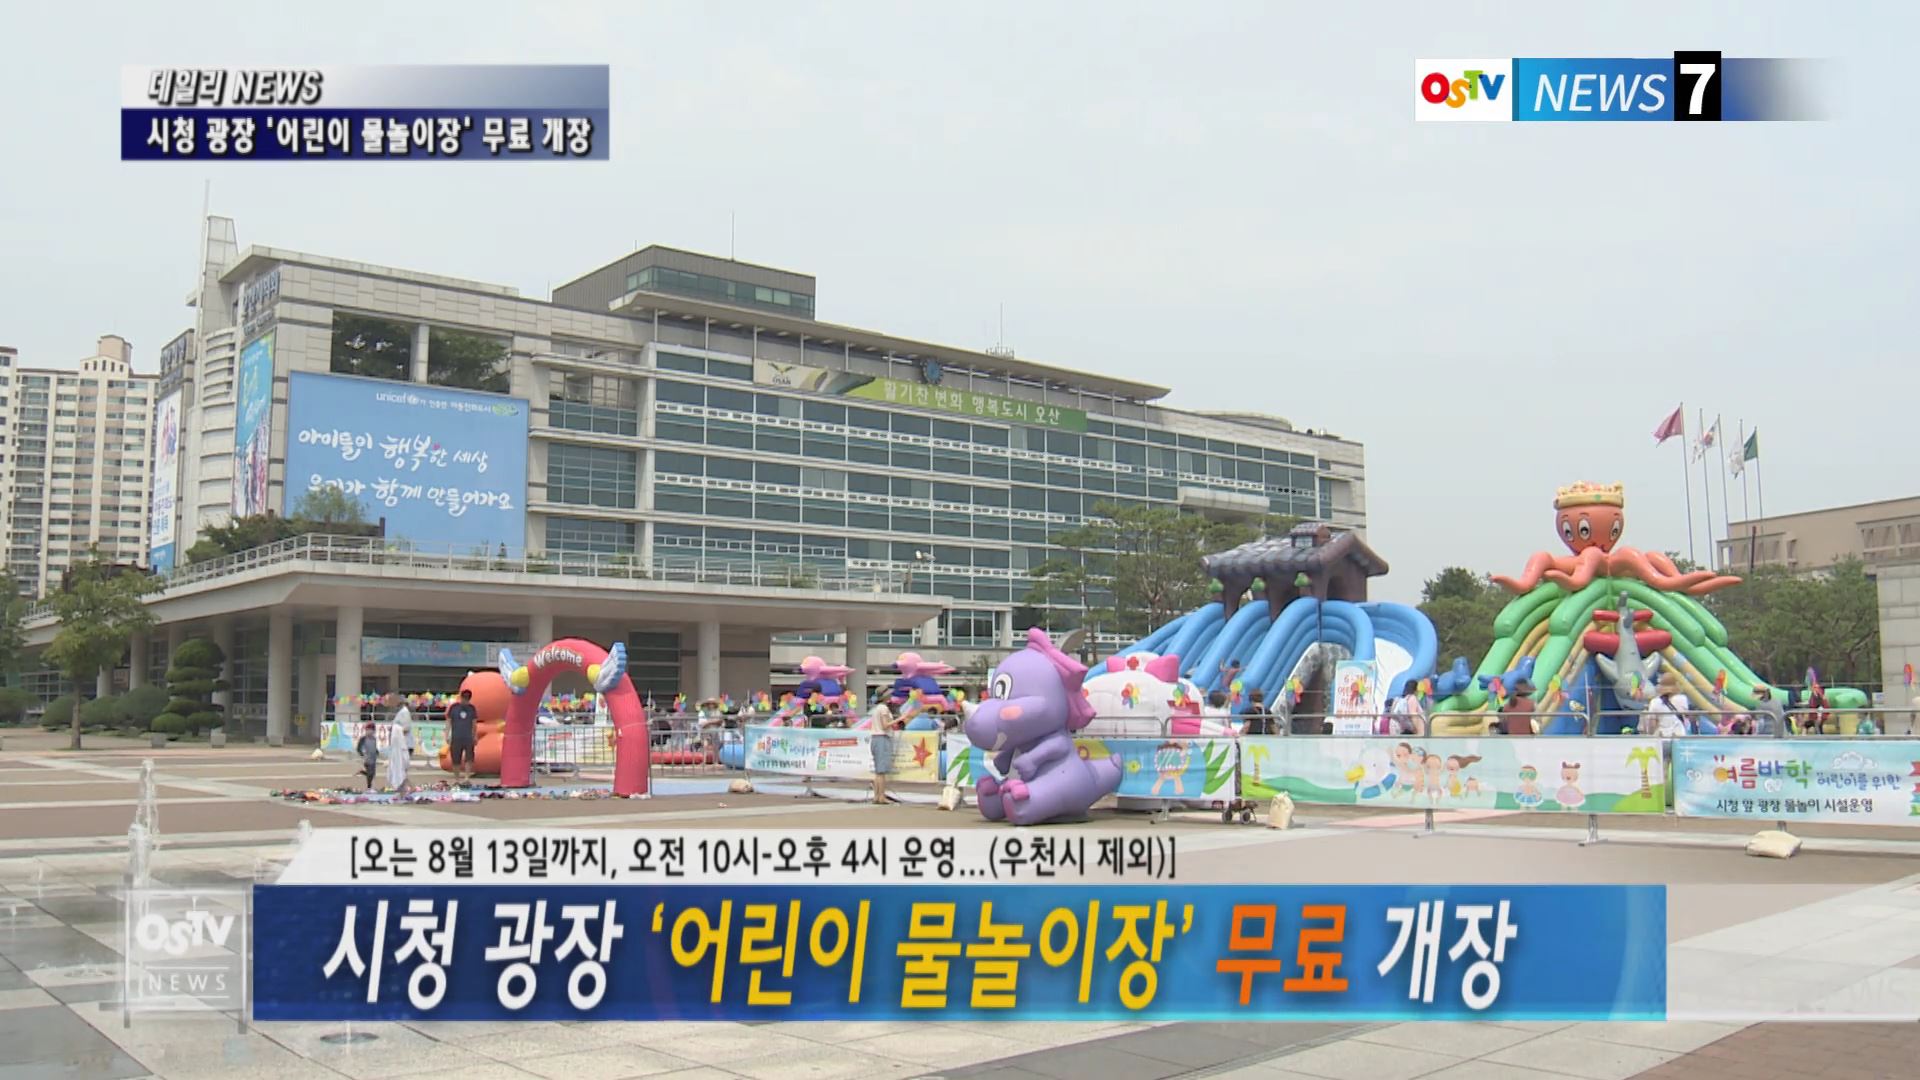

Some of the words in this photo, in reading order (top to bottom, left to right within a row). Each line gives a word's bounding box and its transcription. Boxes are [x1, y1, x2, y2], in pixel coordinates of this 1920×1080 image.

[935, 390, 963, 412] 변화
[972, 394, 1028, 421] 행복도시
[1035, 409, 1061, 426] 오산
[298, 428, 373, 461] 아이들이
[379, 433, 448, 472] 행복한
[453, 449, 488, 473] 세상
[371, 476, 422, 507] 함께
[427, 483, 514, 517] 만들어가요
[533, 645, 582, 669] Welcome
[1872, 774, 1902, 791] 위한
[1716, 799, 1739, 813] 시청
[1743, 799, 1754, 813] 앞
[1758, 799, 1780, 813] 광장
[1785, 799, 1820, 813] 물놀이
[1824, 799, 1873, 813] 시설운영
